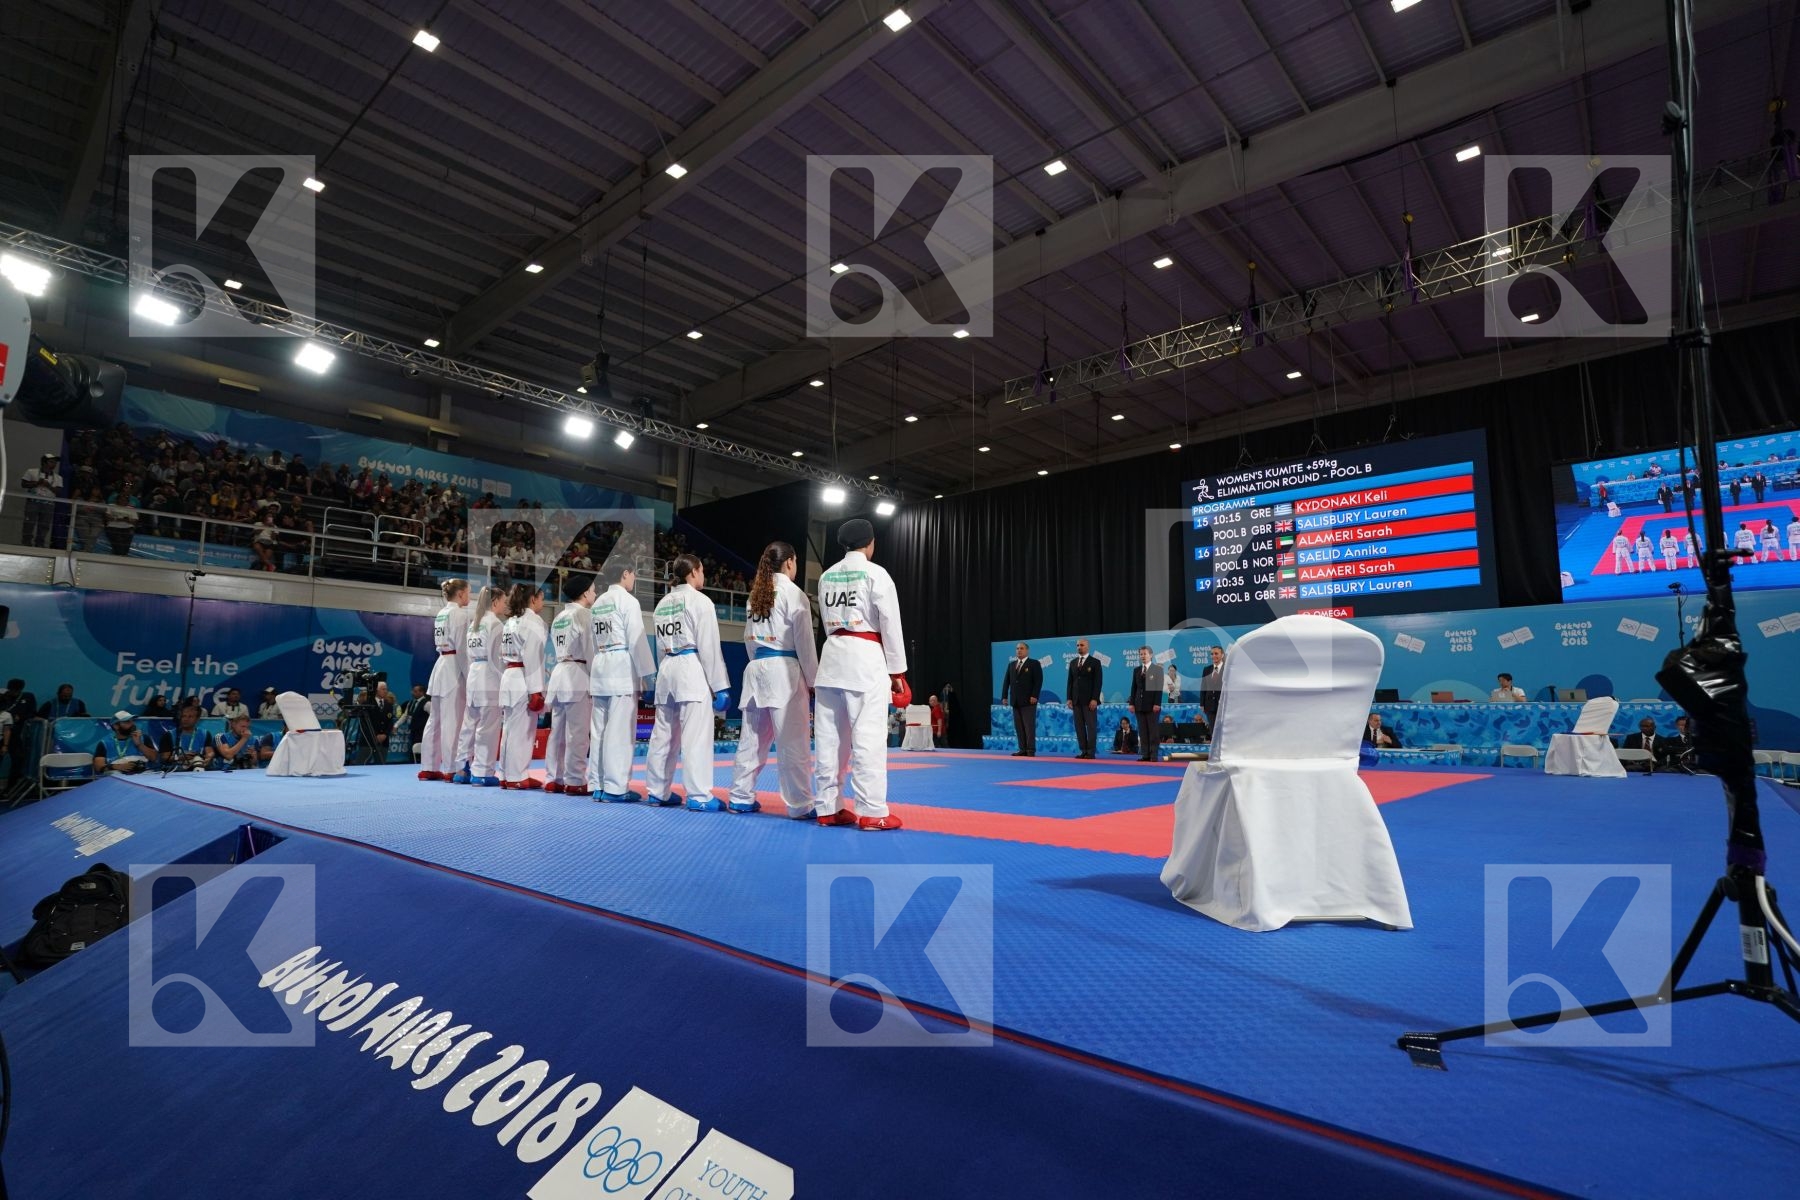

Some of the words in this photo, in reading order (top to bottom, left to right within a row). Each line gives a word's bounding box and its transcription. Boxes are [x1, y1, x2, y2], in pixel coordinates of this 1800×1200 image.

[415, 467, 448, 483] AIRES
[451, 474, 478, 489] 2018
[1217, 470, 1262, 487] WOMEN'S
[1265, 463, 1304, 478] KUMITE
[1306, 459, 1337, 470] +59kg
[1217, 479, 1280, 498] ELIMINATION
[1282, 472, 1320, 487] ROUND
[1330, 465, 1362, 479] POOL
[1365, 463, 1372, 473] B
[1193, 498, 1256, 515] PROGRAMME
[1296, 494, 1361, 513] KYDONAKI
[1364, 490, 1388, 503] Keli
[1197, 517, 1209, 528] 15
[1213, 512, 1242, 525] 10:15
[1250, 508, 1271, 519] GRE
[1298, 512, 1364, 529] SALISBURY
[1364, 507, 1408, 520] Lauren
[1213, 529, 1240, 541] POOL
[1241, 527, 1247, 537] B
[1251, 524, 1272, 535] GBR
[1298, 530, 1354, 546] ALAMERI
[1357, 526, 1393, 539] Sarah
[1198, 548, 1210, 558] 16
[1214, 544, 1243, 557] 10:20
[1252, 540, 1273, 552] UAE
[1299, 549, 1341, 563] SAELID
[1344, 545, 1387, 558] Annika
[1215, 560, 1241, 572] POOL
[1243, 560, 1249, 569] B
[1253, 557, 1274, 568] NOR
[1300, 565, 1356, 580] ALAMERI
[1359, 561, 1395, 574] Sarah
[1200, 580, 1211, 590] 19
[1216, 576, 1245, 588] 10:35
[1254, 573, 1275, 584] UAE
[1301, 582, 1366, 597] SALISBURY
[1369, 580, 1412, 592] Lauren
[825, 591, 857, 607] UAE
[1216, 593, 1242, 604] POOL
[1244, 592, 1250, 602] B
[1255, 590, 1276, 601] GBR
[1313, 609, 1348, 618] OMEGA
[594, 621, 613, 634] JPN
[656, 621, 682, 637] NOR
[1444, 628, 1477, 638] BUENOS
[1555, 621, 1592, 630] BUENOS
[1560, 630, 1588, 638] AIRES
[312, 638, 383, 656] BUENOS
[1451, 643, 1473, 652] 2018
[1562, 638, 1589, 646] 2018
[116, 652, 182, 674] Feel
[192, 654, 239, 676] the
[258, 945, 400, 1032] BUENOS
[349, 995, 493, 1090] AIRES
[442, 1044, 603, 1163] 2018
[698, 1159, 768, 1200] YOUTH
